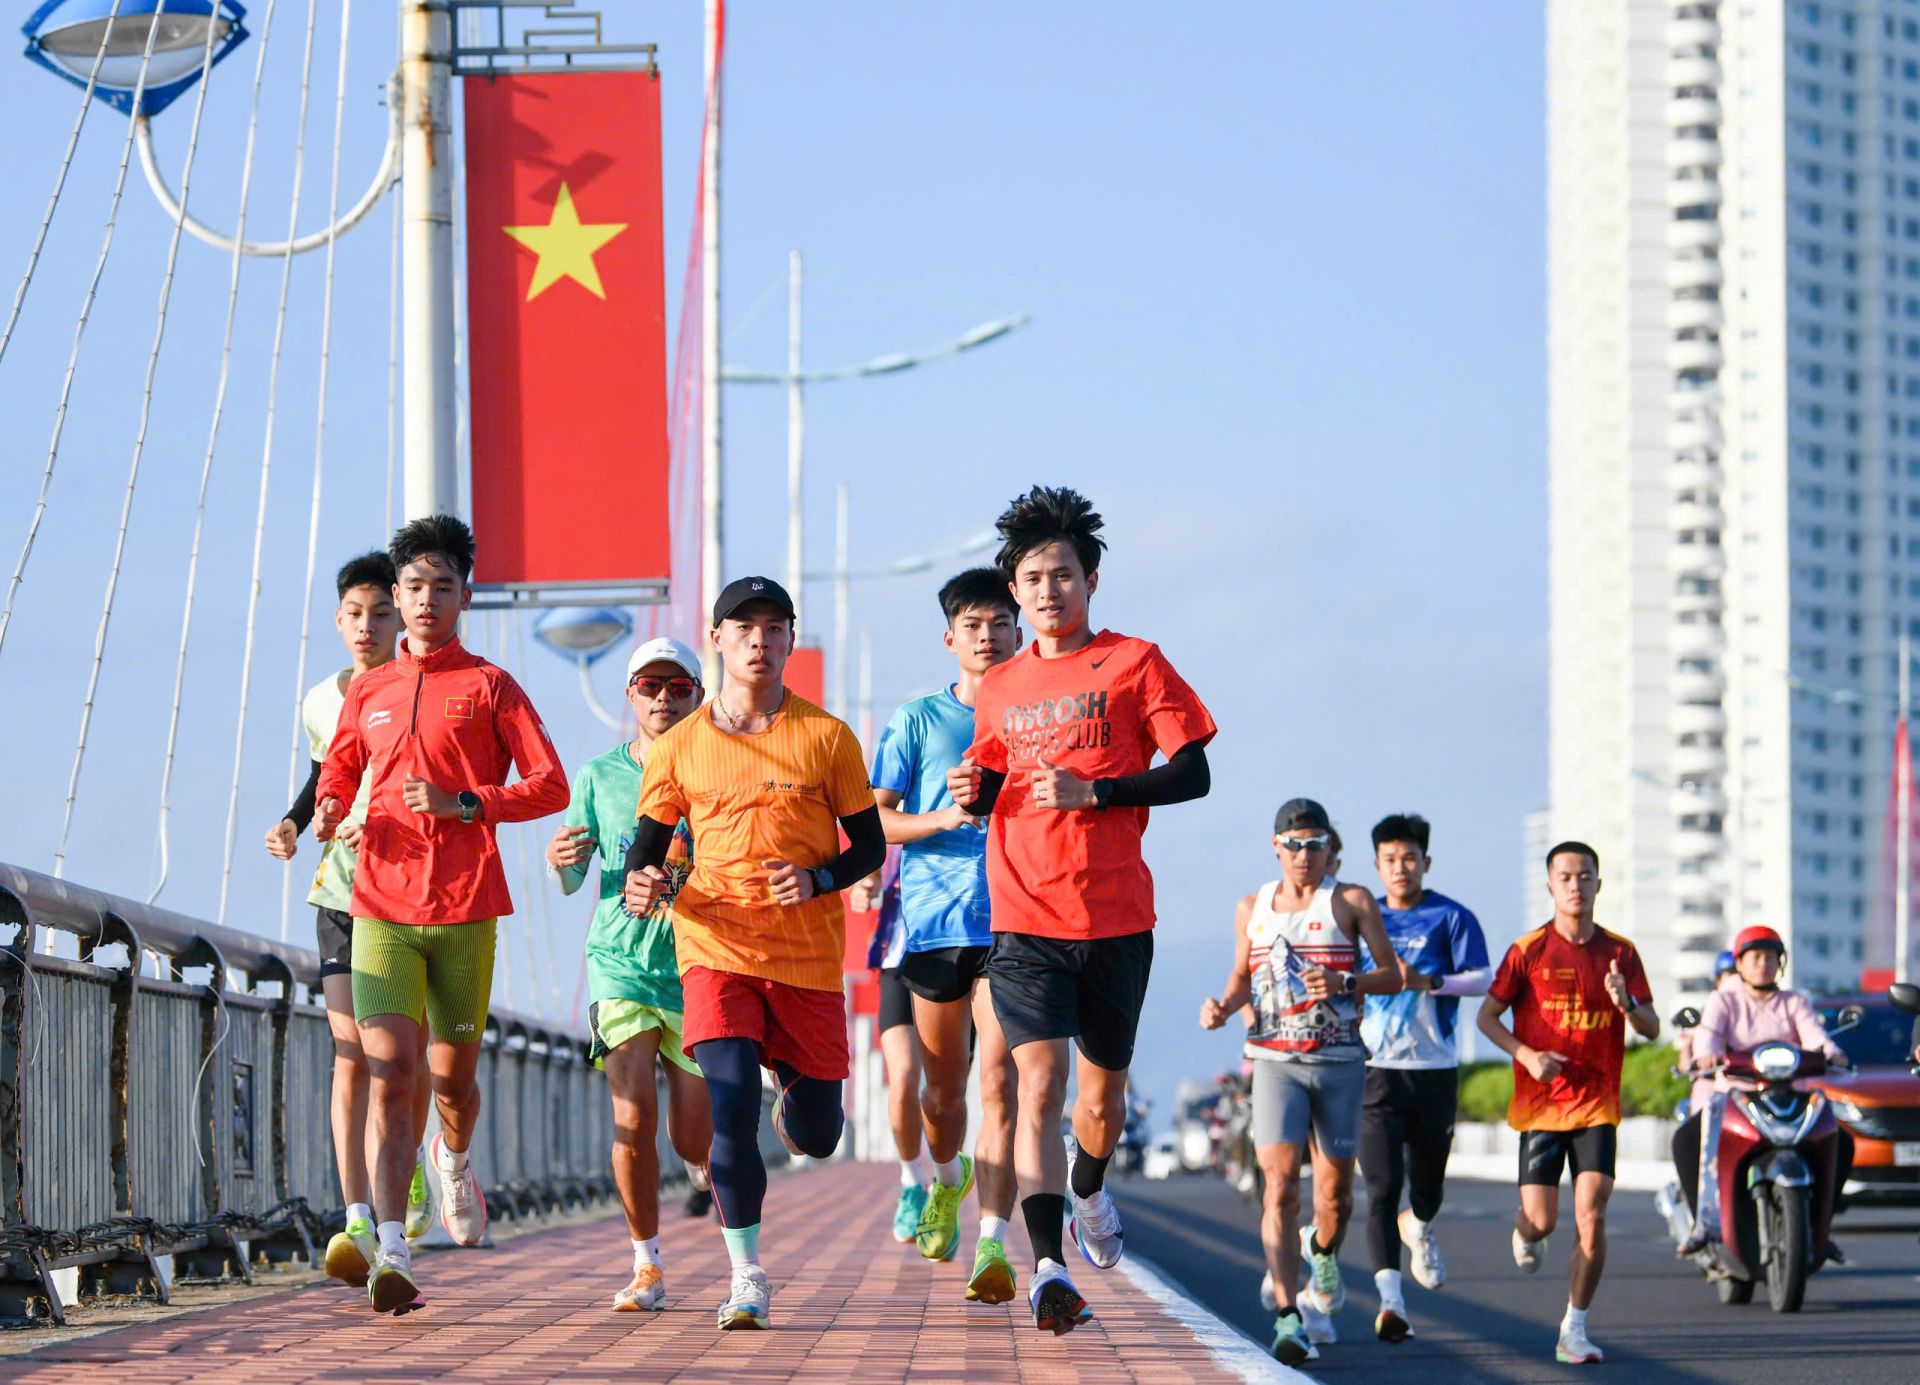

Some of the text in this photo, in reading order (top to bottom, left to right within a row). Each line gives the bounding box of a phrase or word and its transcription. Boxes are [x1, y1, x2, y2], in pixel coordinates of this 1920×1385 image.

[1003, 690, 1107, 735] SWOOSH
[1067, 721, 1111, 751] CLUB
[1558, 1010, 1613, 1031] RUN
